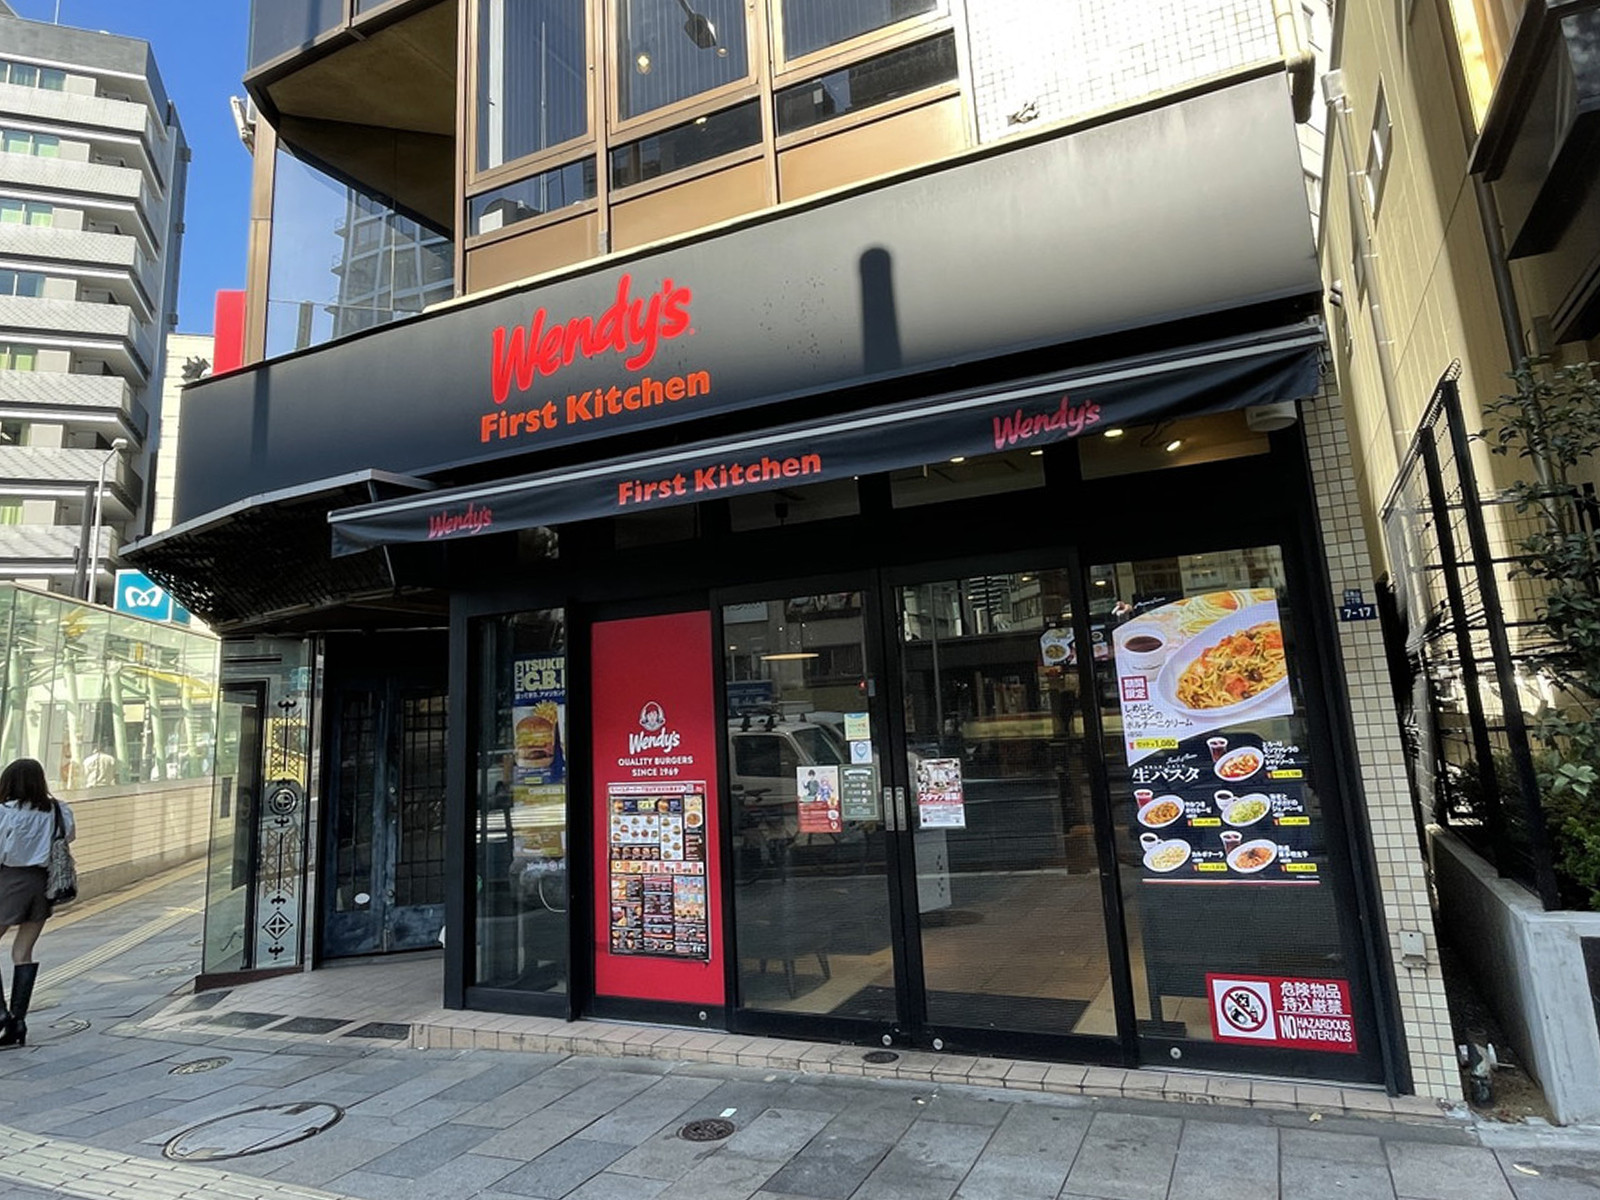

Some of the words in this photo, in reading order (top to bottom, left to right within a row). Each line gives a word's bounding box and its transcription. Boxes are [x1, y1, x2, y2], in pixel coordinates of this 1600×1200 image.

[491, 273, 692, 404] Wendy's
[480, 401, 557, 443] First
[566, 370, 711, 424] Kitchen
[992, 396, 1102, 450] Wendy's
[618, 474, 687, 506] First
[694, 453, 822, 492] Kitchen
[427, 503, 493, 539] Wendy's
[1343, 607, 1371, 619] 7-17
[1124, 704, 1154, 713] しめじと
[1125, 711, 1163, 720] ベーコンの
[629, 727, 680, 755] Wendy's
[617, 757, 653, 766] QUALITY
[654, 755, 694, 765] BURGERS
[631, 768, 657, 777] SINCE
[659, 767, 679, 776] 1969
[1132, 766, 1200, 784] 生パスタ
[1280, 981, 1341, 1000] 危険物品
[1282, 998, 1343, 1014] 持込厳禁
[1278, 1014, 1297, 1040] NO
[1297, 1017, 1351, 1031] HAZARDOUS
[1297, 1029, 1352, 1043] MATERIALS
